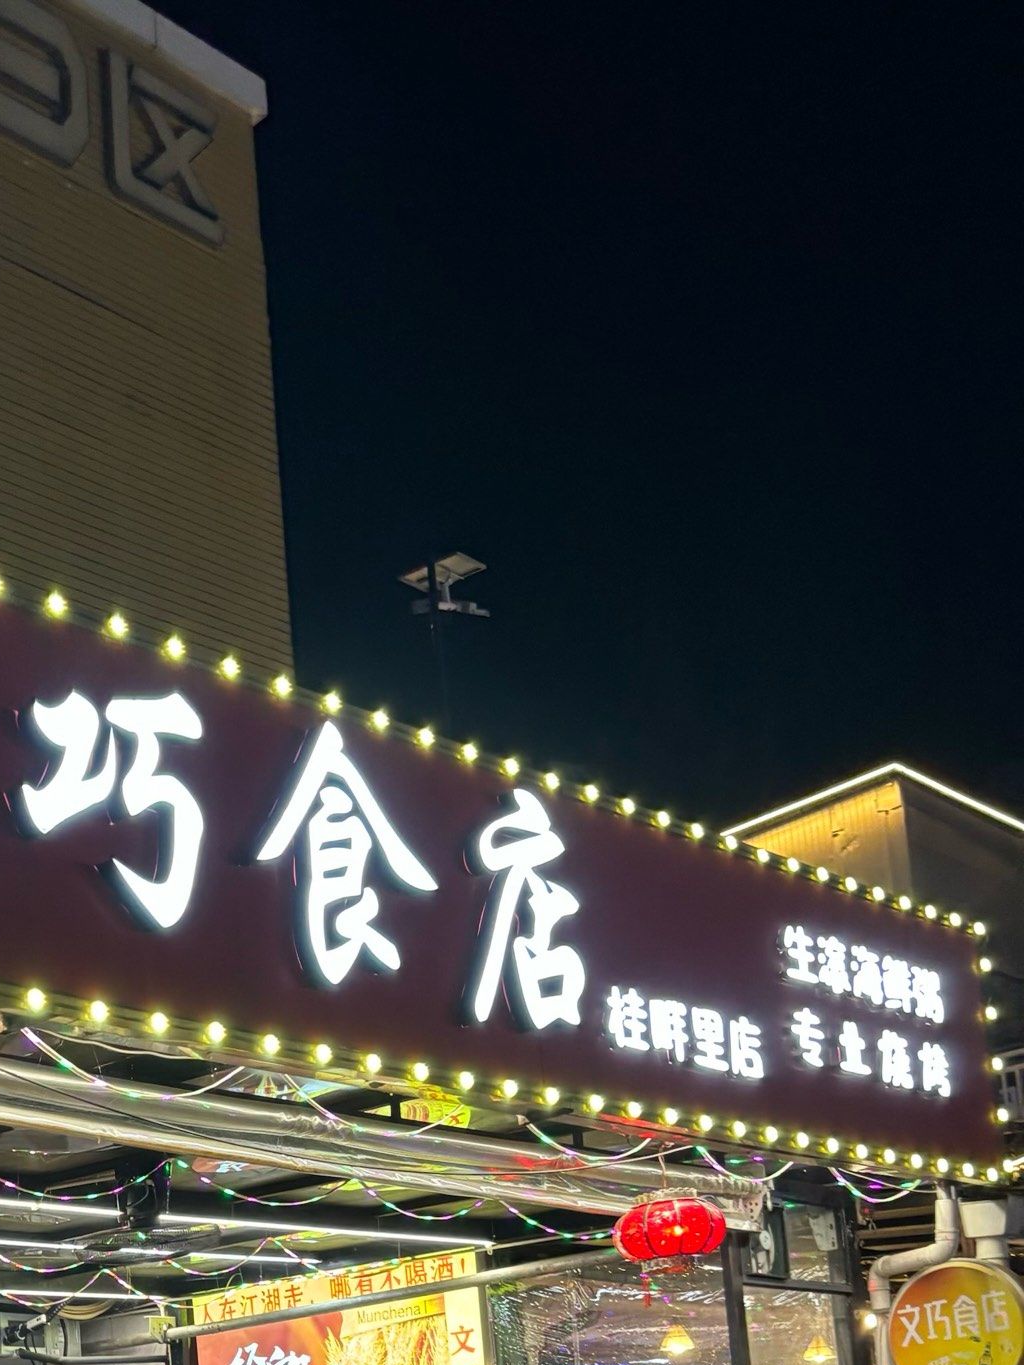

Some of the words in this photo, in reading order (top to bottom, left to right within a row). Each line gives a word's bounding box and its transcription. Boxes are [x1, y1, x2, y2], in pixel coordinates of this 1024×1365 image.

[607, 985, 764, 1079] 桂畔里店
[357, 1299, 428, 1324] Munchenal
[897, 1289, 1010, 1348] 文巧食店
